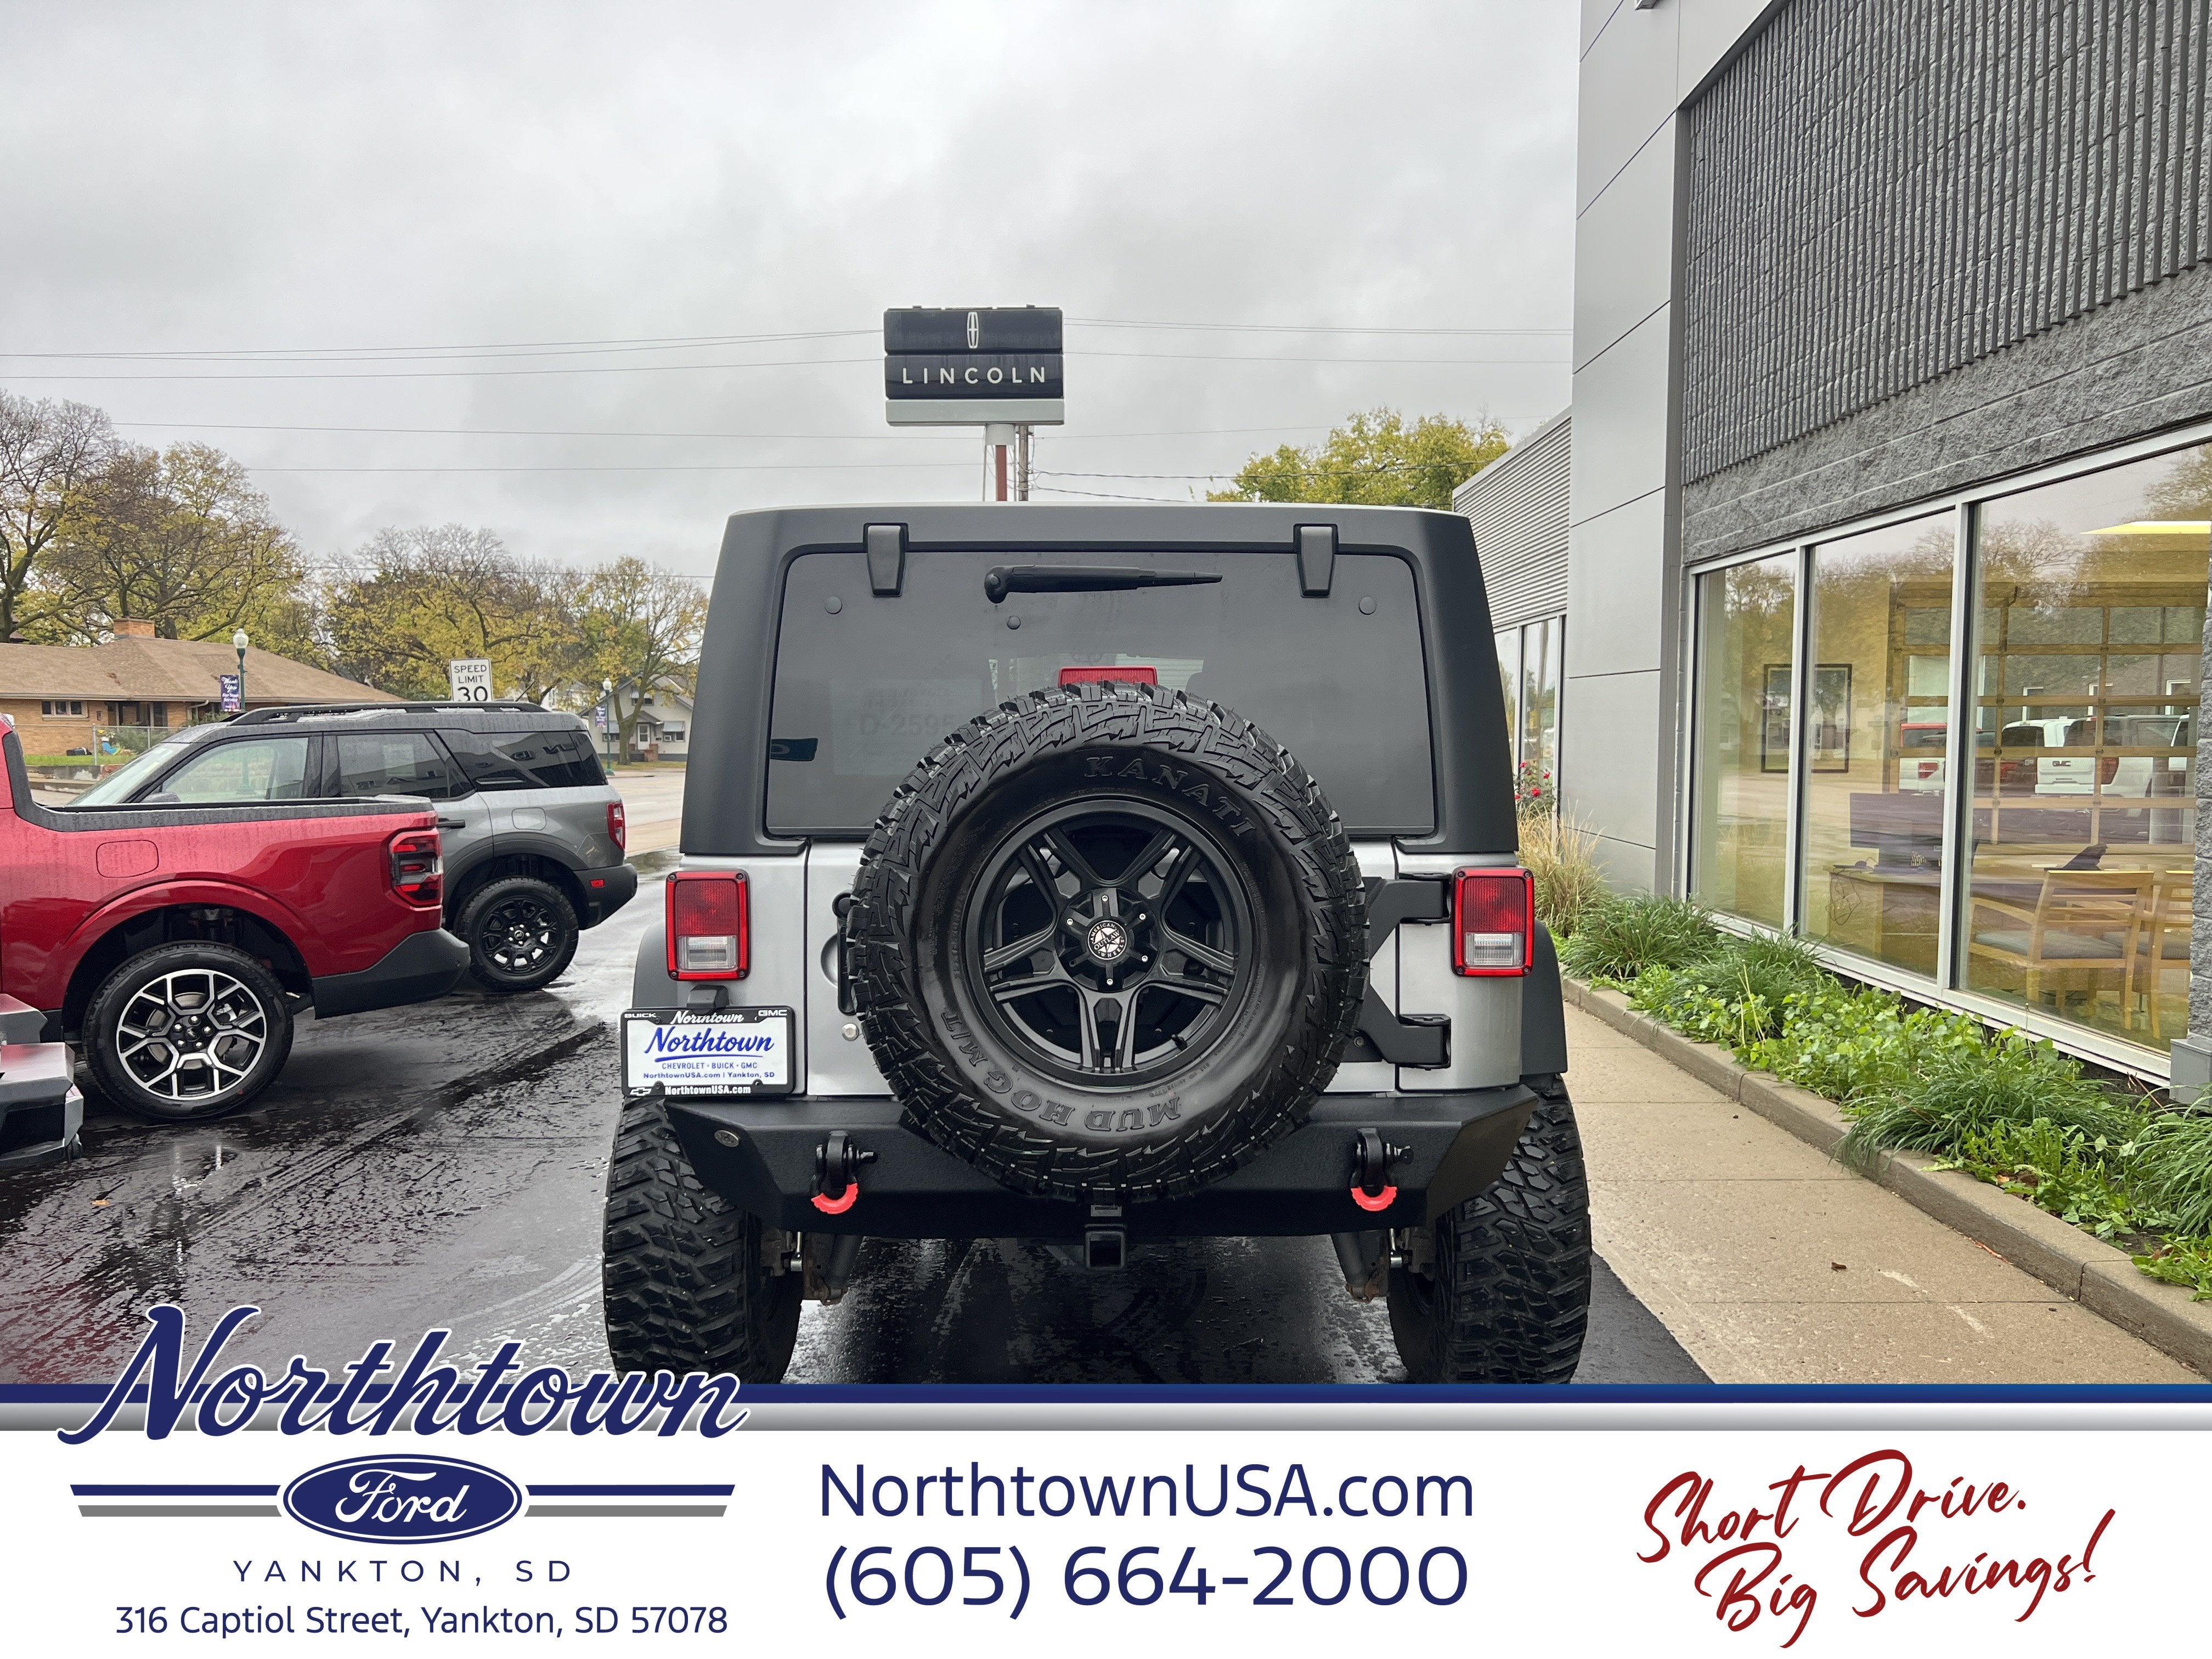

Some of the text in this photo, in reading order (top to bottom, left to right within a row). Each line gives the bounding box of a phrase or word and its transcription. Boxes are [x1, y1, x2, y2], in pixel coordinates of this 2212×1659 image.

[902, 366, 1045, 384] LINCOLN
[454, 664, 487, 673] SPEED
[458, 675, 484, 684] LIMIT
[458, 686, 488, 702] 30
[1084, 755, 1257, 838] KANATI
[1090, 923, 1115, 941] AMERICAN
[1093, 929, 1120, 950] OUTLAW
[1101, 939, 1125, 958] WHEELS
[644, 1026, 775, 1054] Northtown
[665, 1086, 751, 1096] NorthtownUSA.com
[983, 1069, 1075, 1126] HOG
[1084, 1097, 1182, 1132] MUD
